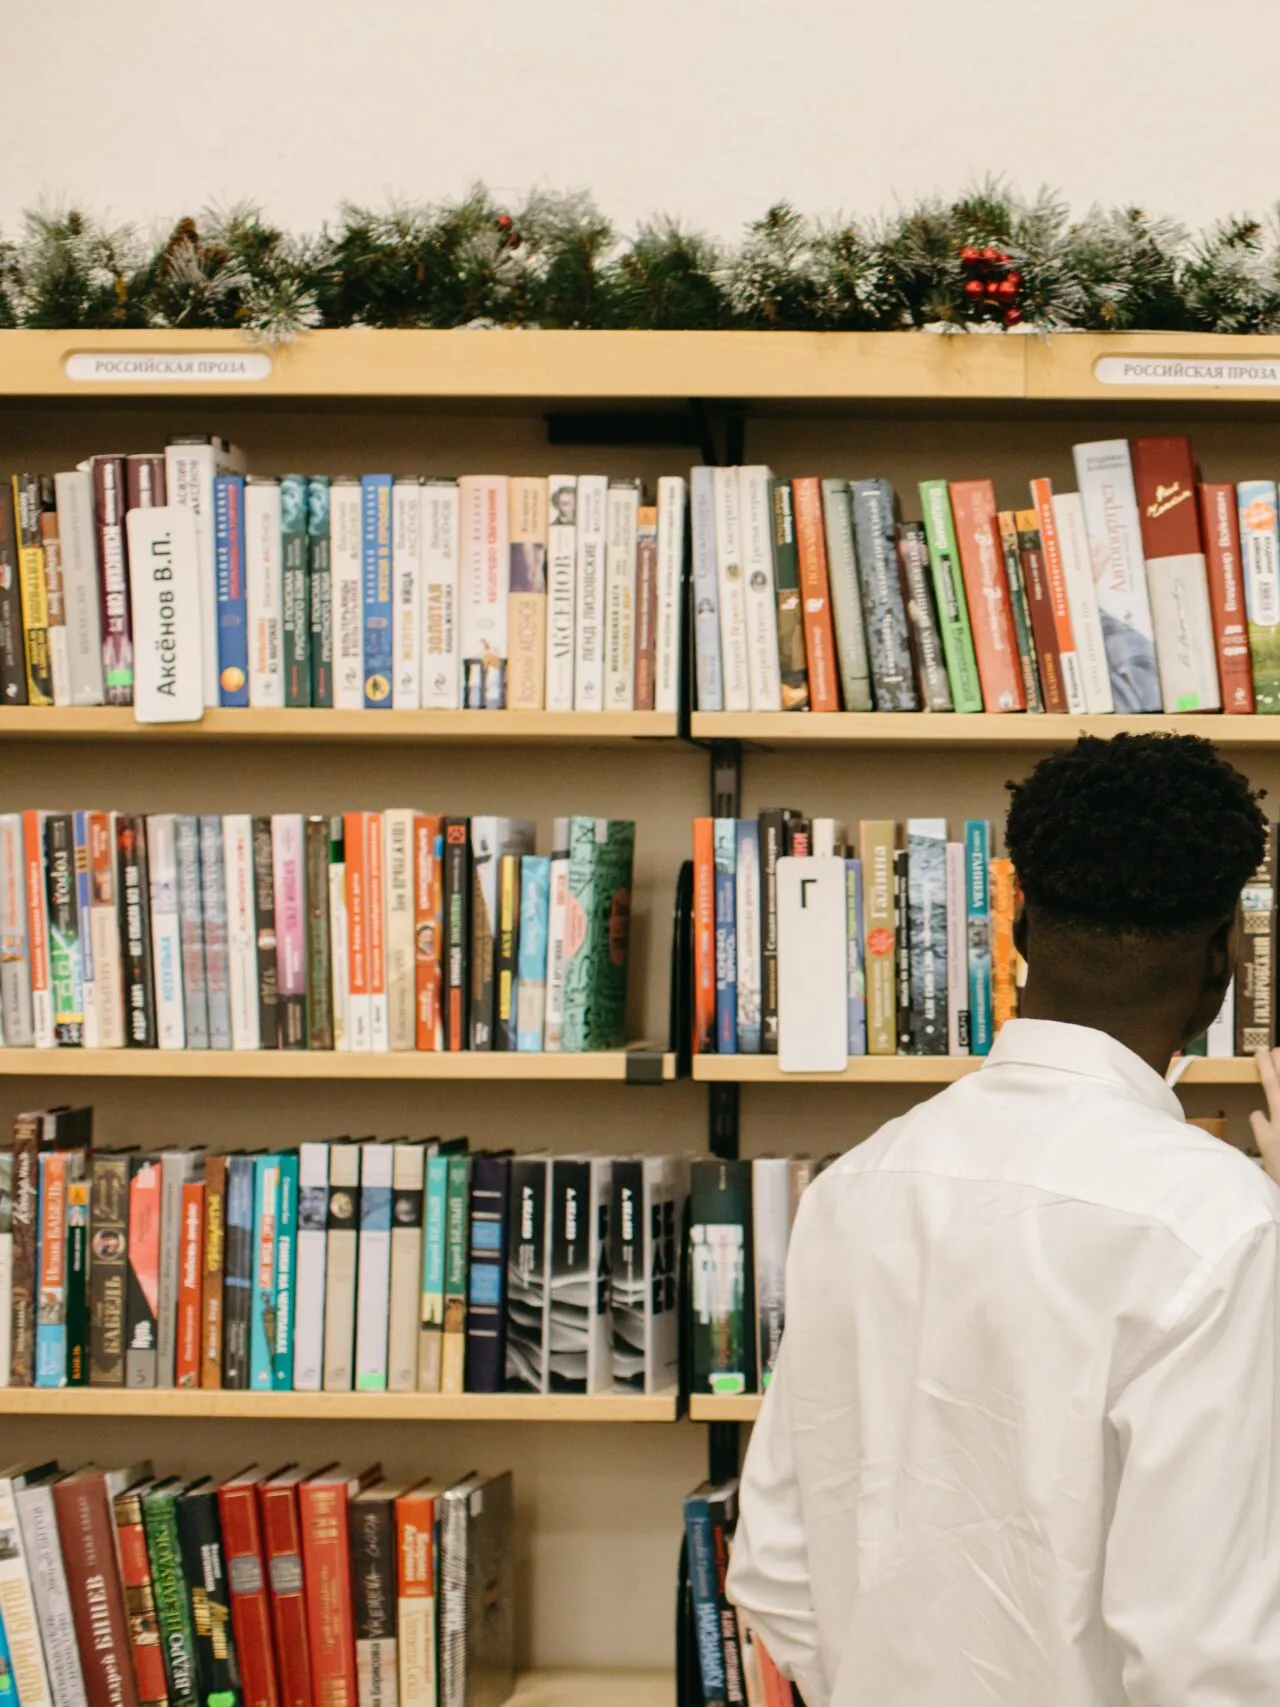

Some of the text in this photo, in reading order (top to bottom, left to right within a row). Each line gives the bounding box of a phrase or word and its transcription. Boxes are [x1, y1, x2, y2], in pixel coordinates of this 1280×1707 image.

[95, 358, 247, 374] РОССИЙСКАЯ ПРОЗА
[1123, 362, 1278, 381] РОССИЙСКАЯ ПРОЗА
[151, 532, 177, 696] Аксёнов В.П.
[428, 583, 442, 655] ЗОЛОТАЯ
[801, 879, 817, 909] Г
[871, 845, 887, 918] Галина
[1252, 937, 1270, 1023] ГИЛЯРОВСКИЙ
[103, 1275, 121, 1354] БАБЕЛЬ
